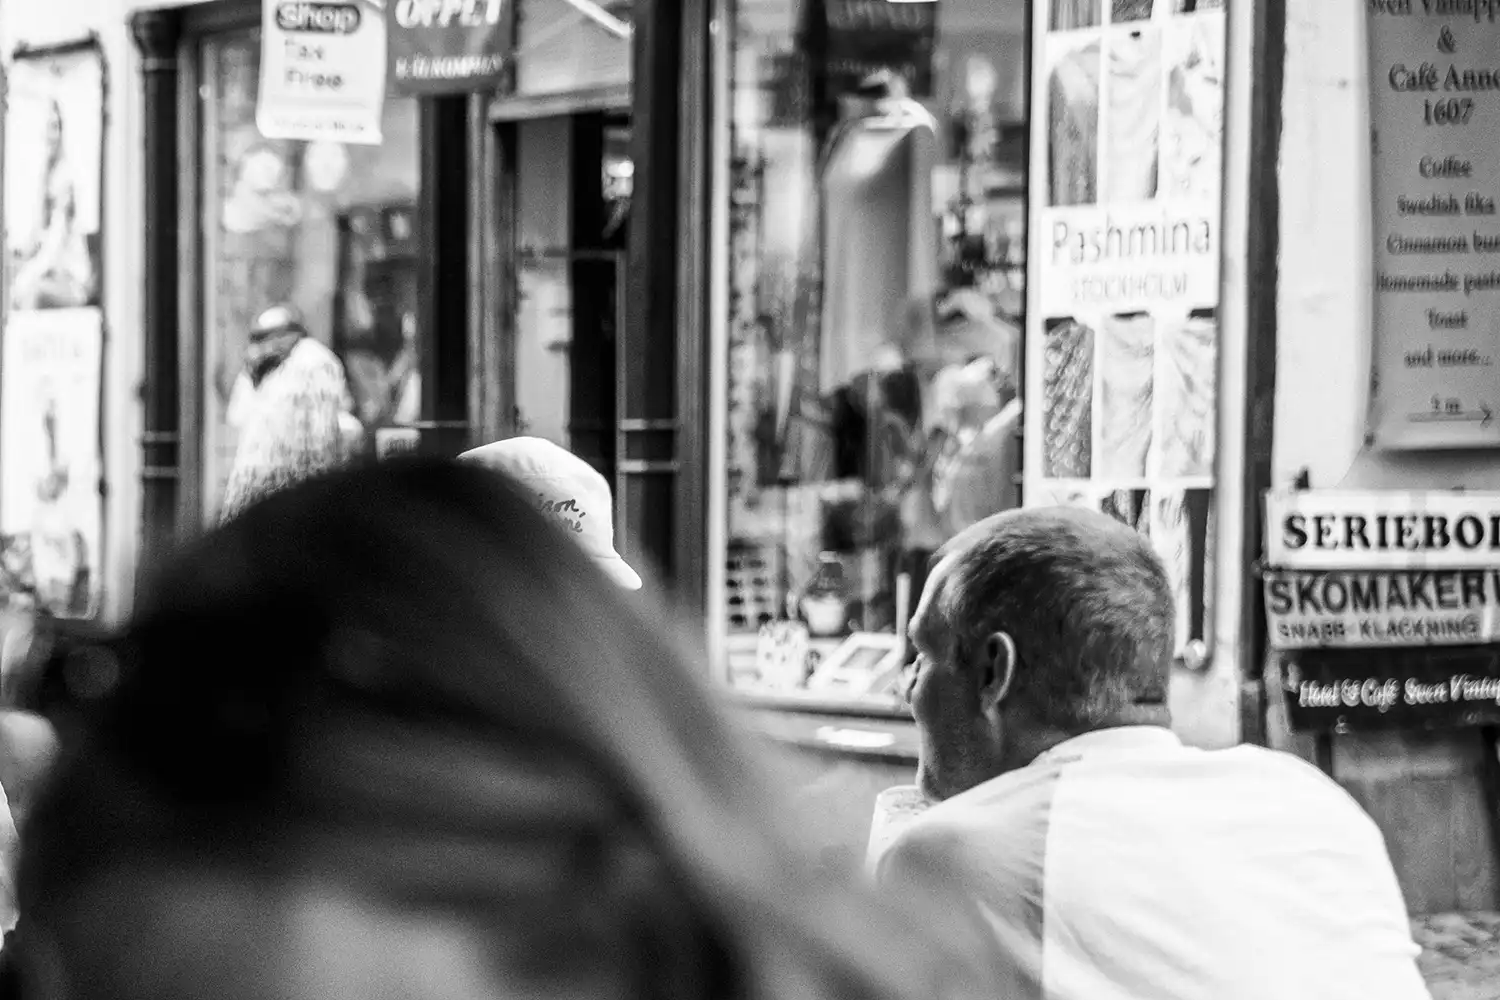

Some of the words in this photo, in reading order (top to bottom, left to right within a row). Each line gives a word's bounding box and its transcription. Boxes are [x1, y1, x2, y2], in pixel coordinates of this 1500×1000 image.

[280, 4, 357, 33] Shop
[1437, 25, 1456, 53] &
[1389, 62, 1439, 92] Café
[1425, 98, 1474, 125] 1607
[1052, 212, 1211, 264] Pashmina
